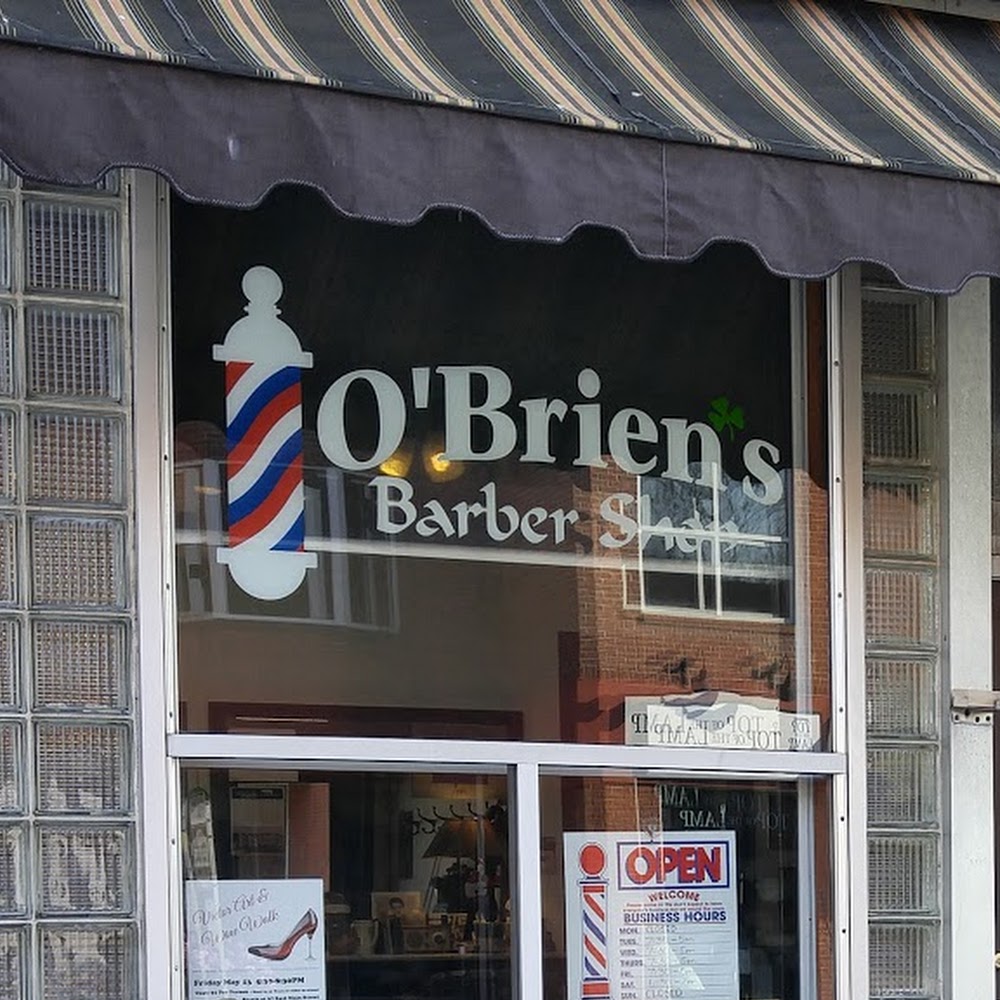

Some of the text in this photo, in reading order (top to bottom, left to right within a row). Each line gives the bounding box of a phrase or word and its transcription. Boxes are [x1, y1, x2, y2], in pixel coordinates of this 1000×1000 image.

[369, 476, 740, 555] Barber Shop
[625, 846, 722, 885] OPEN
[647, 889, 701, 903] WELCOME
[624, 910, 727, 923] BUSINESS HOURS
[193, 978, 221, 987] Friday
[223, 977, 240, 986] May
